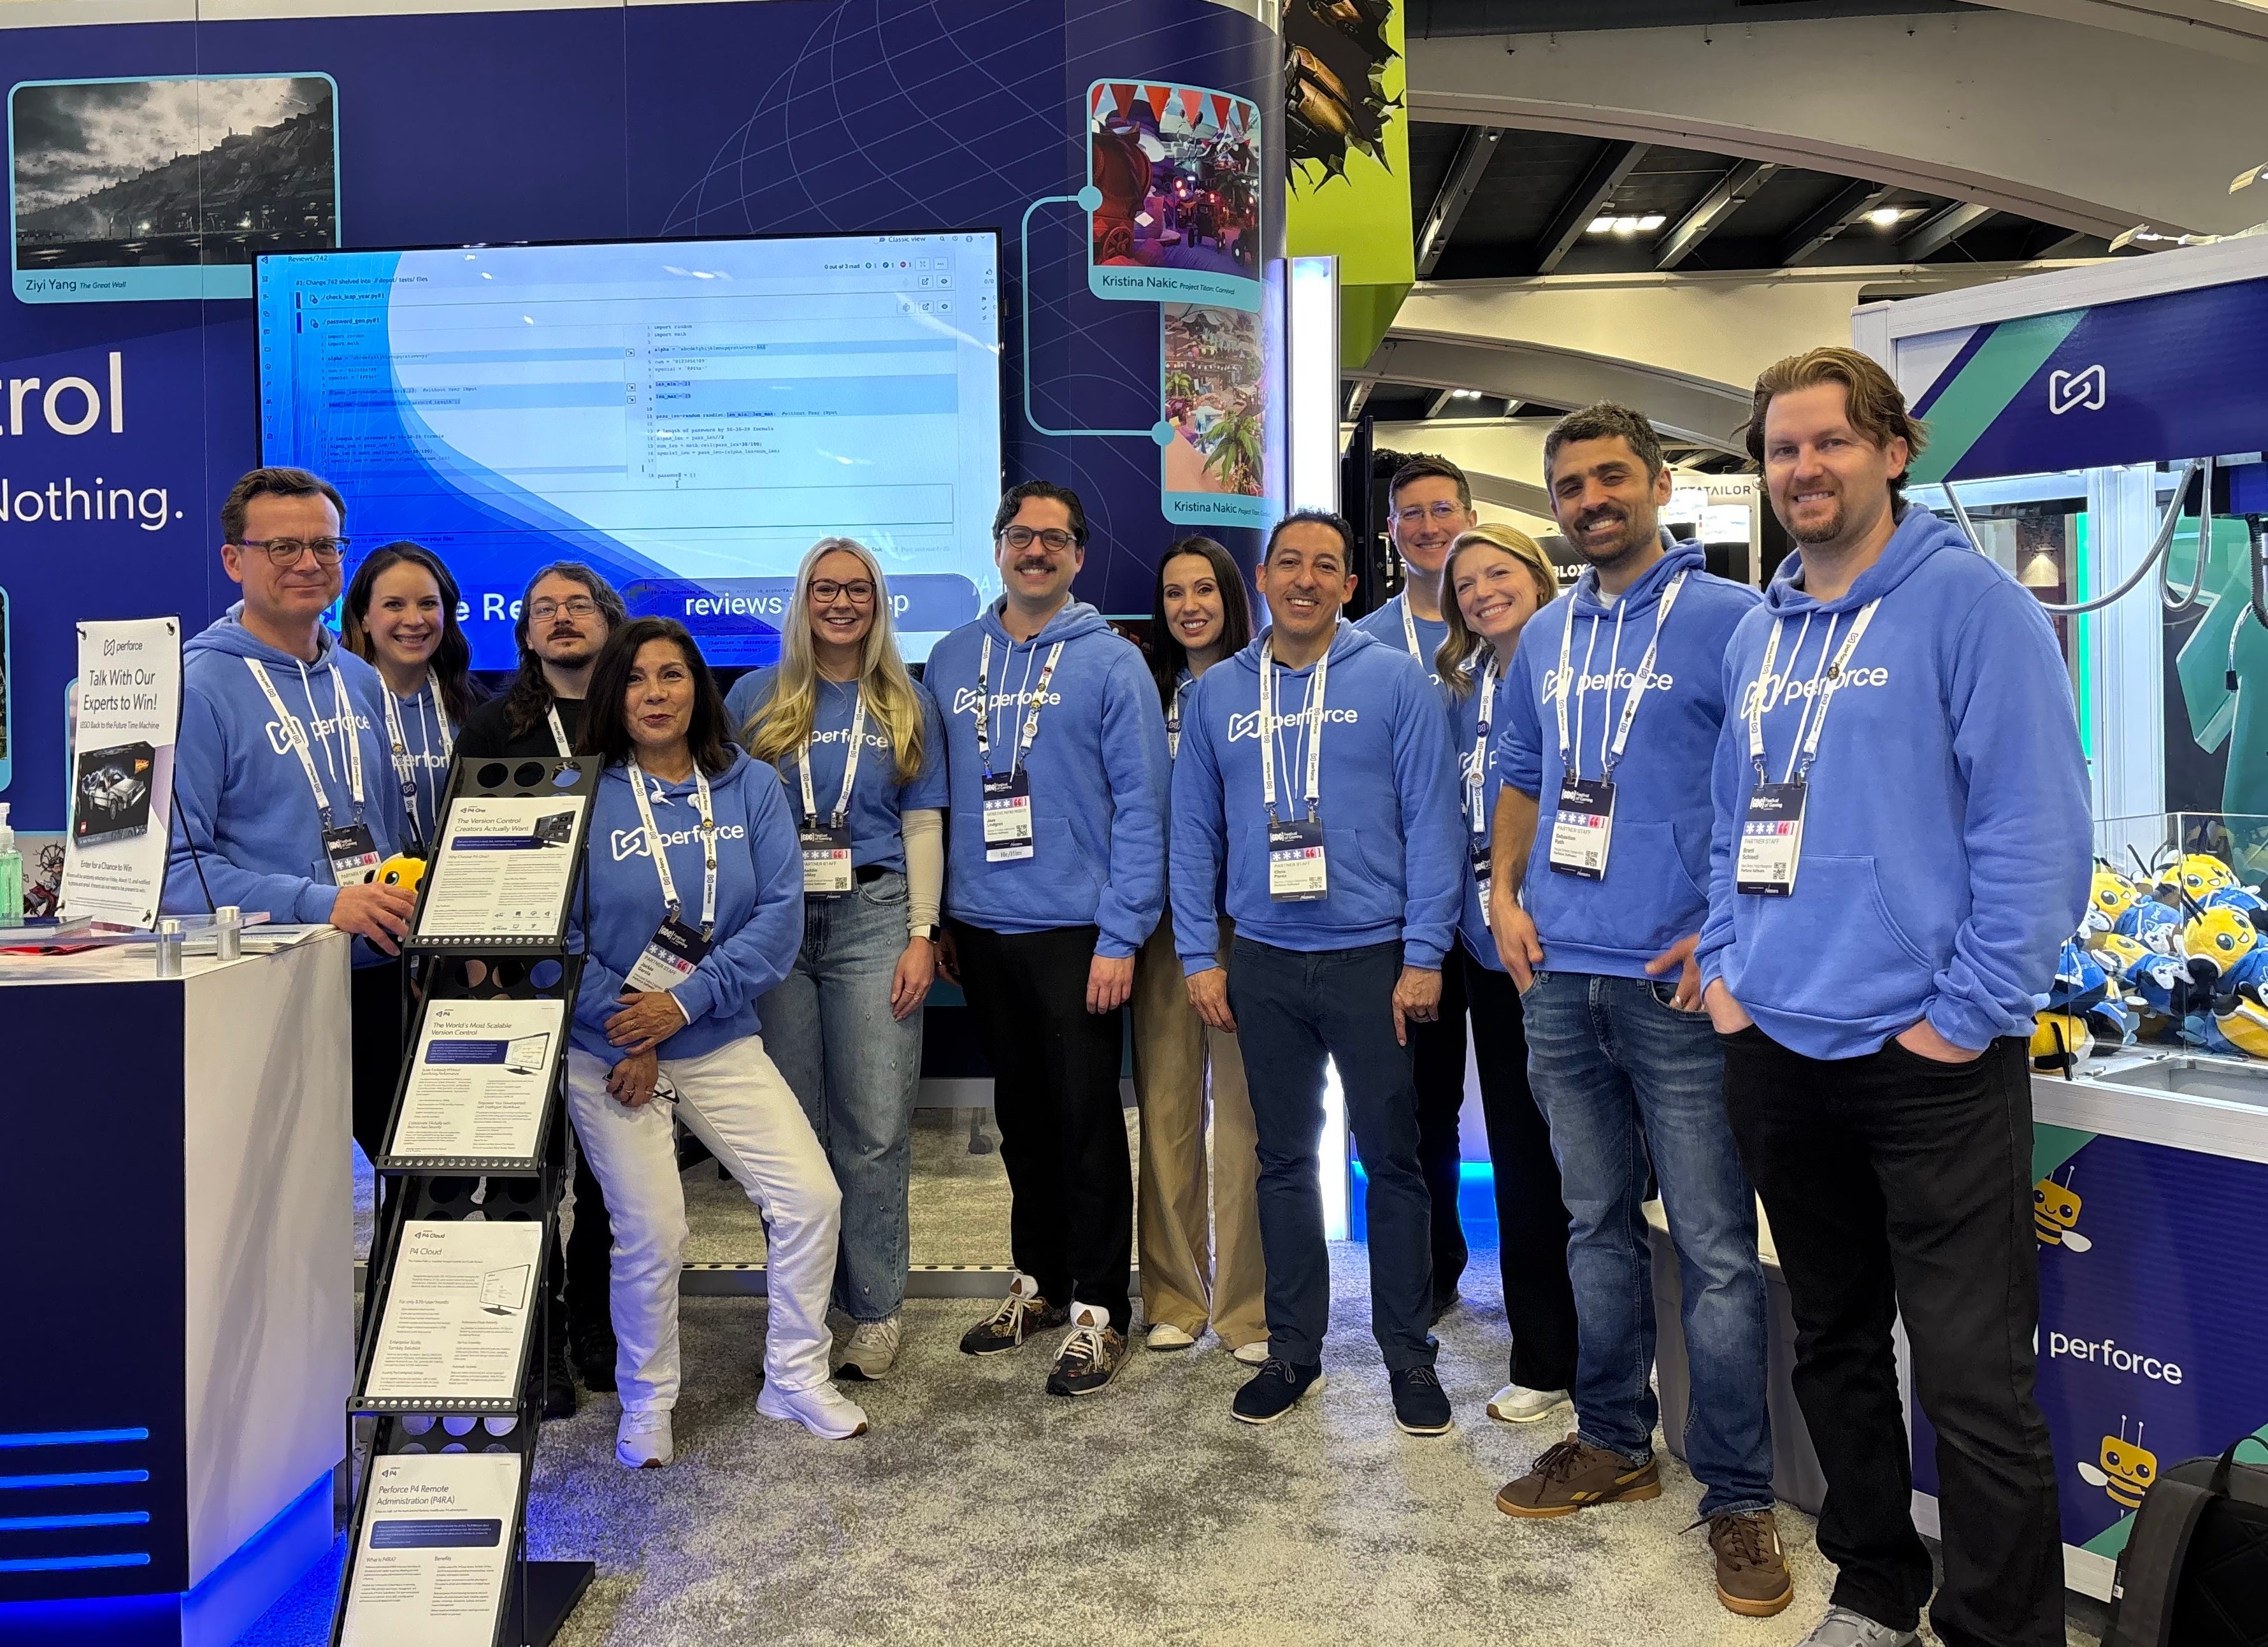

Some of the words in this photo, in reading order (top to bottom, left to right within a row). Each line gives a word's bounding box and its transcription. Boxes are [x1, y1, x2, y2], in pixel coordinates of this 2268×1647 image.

[25, 278, 47, 291] Ziyi
[48, 278, 76, 292] Yang
[92, 281, 111, 289] Great
[112, 280, 126, 289] Wall
[1102, 275, 1144, 287] Kristina
[1147, 277, 1177, 289] Nakic
[1180, 282, 1199, 291] Project
[0, 352, 124, 435] rol
[0, 477, 183, 531] othing.
[1174, 500, 1210, 512] Kristina
[1213, 502, 1237, 514] Nakic
[685, 592, 782, 615] reviews
[117, 640, 143, 653] perforce
[89, 670, 107, 686] Talk
[110, 669, 132, 686] With
[134, 668, 155, 686] Our
[1576, 667, 1674, 697] perfoce
[1784, 666, 1888, 706] perorce
[83, 694, 118, 714] Experts
[120, 695, 131, 710] to
[133, 693, 157, 710] Win!
[989, 687, 1061, 712] perfoce
[81, 860, 91, 868] Enter
[102, 861, 117, 871] Chance
[123, 863, 133, 872] Win
[2049, 1331, 2183, 1385] perforce
[378, 1485, 409, 1494] Perforce
[421, 1485, 449, 1493] Remote
[377, 1497, 429, 1505] Administration
[430, 1495, 456, 1505] (P4RA)
